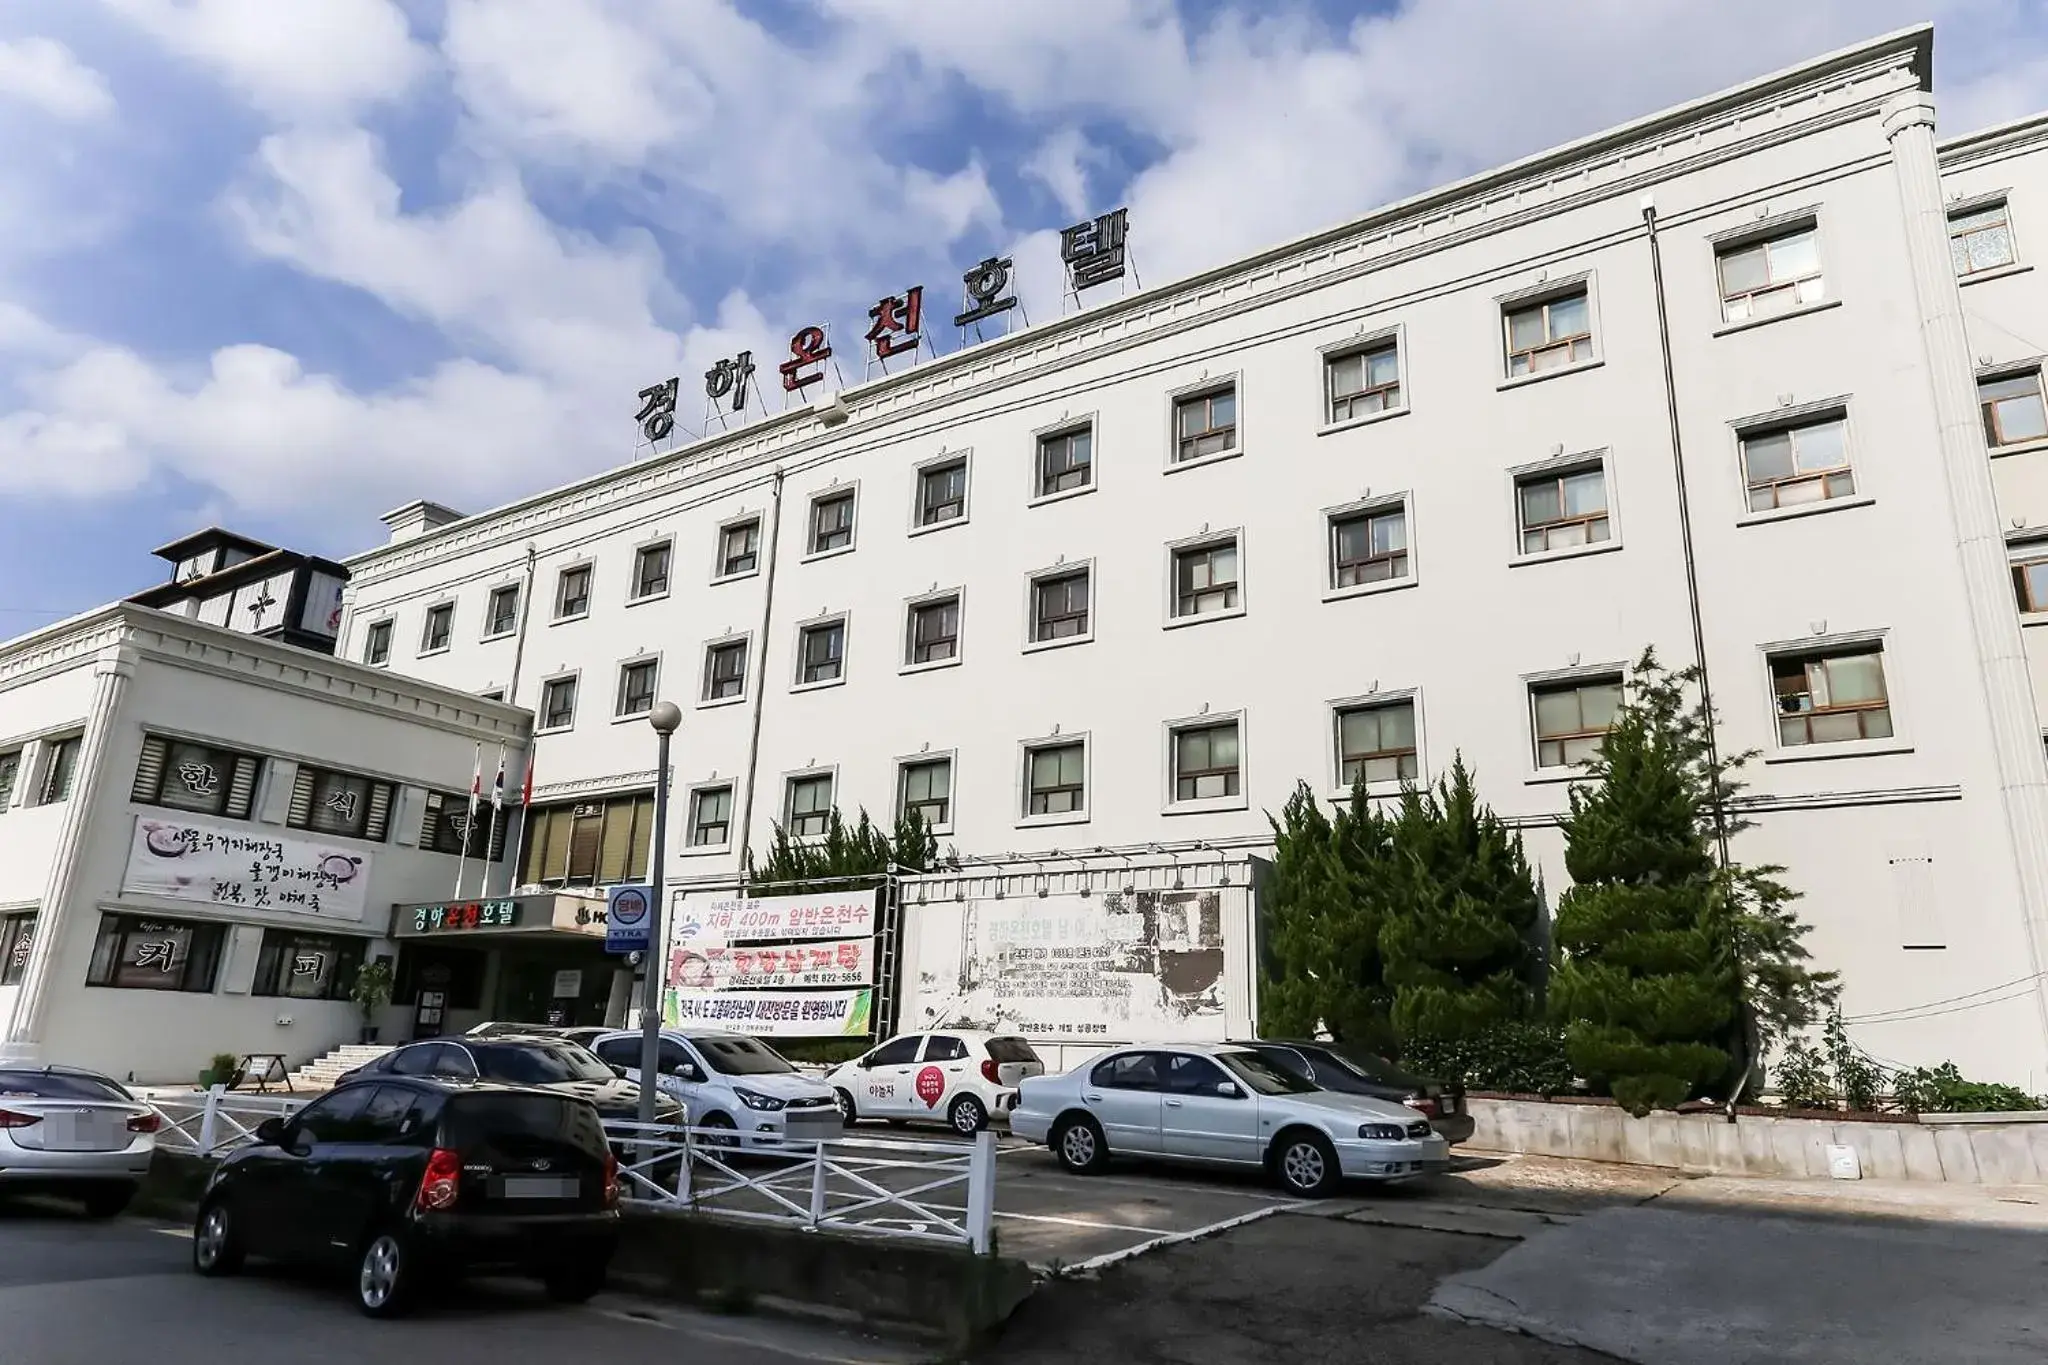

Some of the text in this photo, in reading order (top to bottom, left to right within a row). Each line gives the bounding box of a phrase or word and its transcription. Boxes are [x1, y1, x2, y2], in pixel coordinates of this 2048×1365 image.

[634, 207, 1130, 442] 경하온천호텔
[414, 902, 514, 931] 경하온천호텔
[706, 904, 869, 929] 지하 400m 암반온천수
[801, 999, 848, 1021] 환영합니다
[869, 1084, 895, 1099] 야놀자
